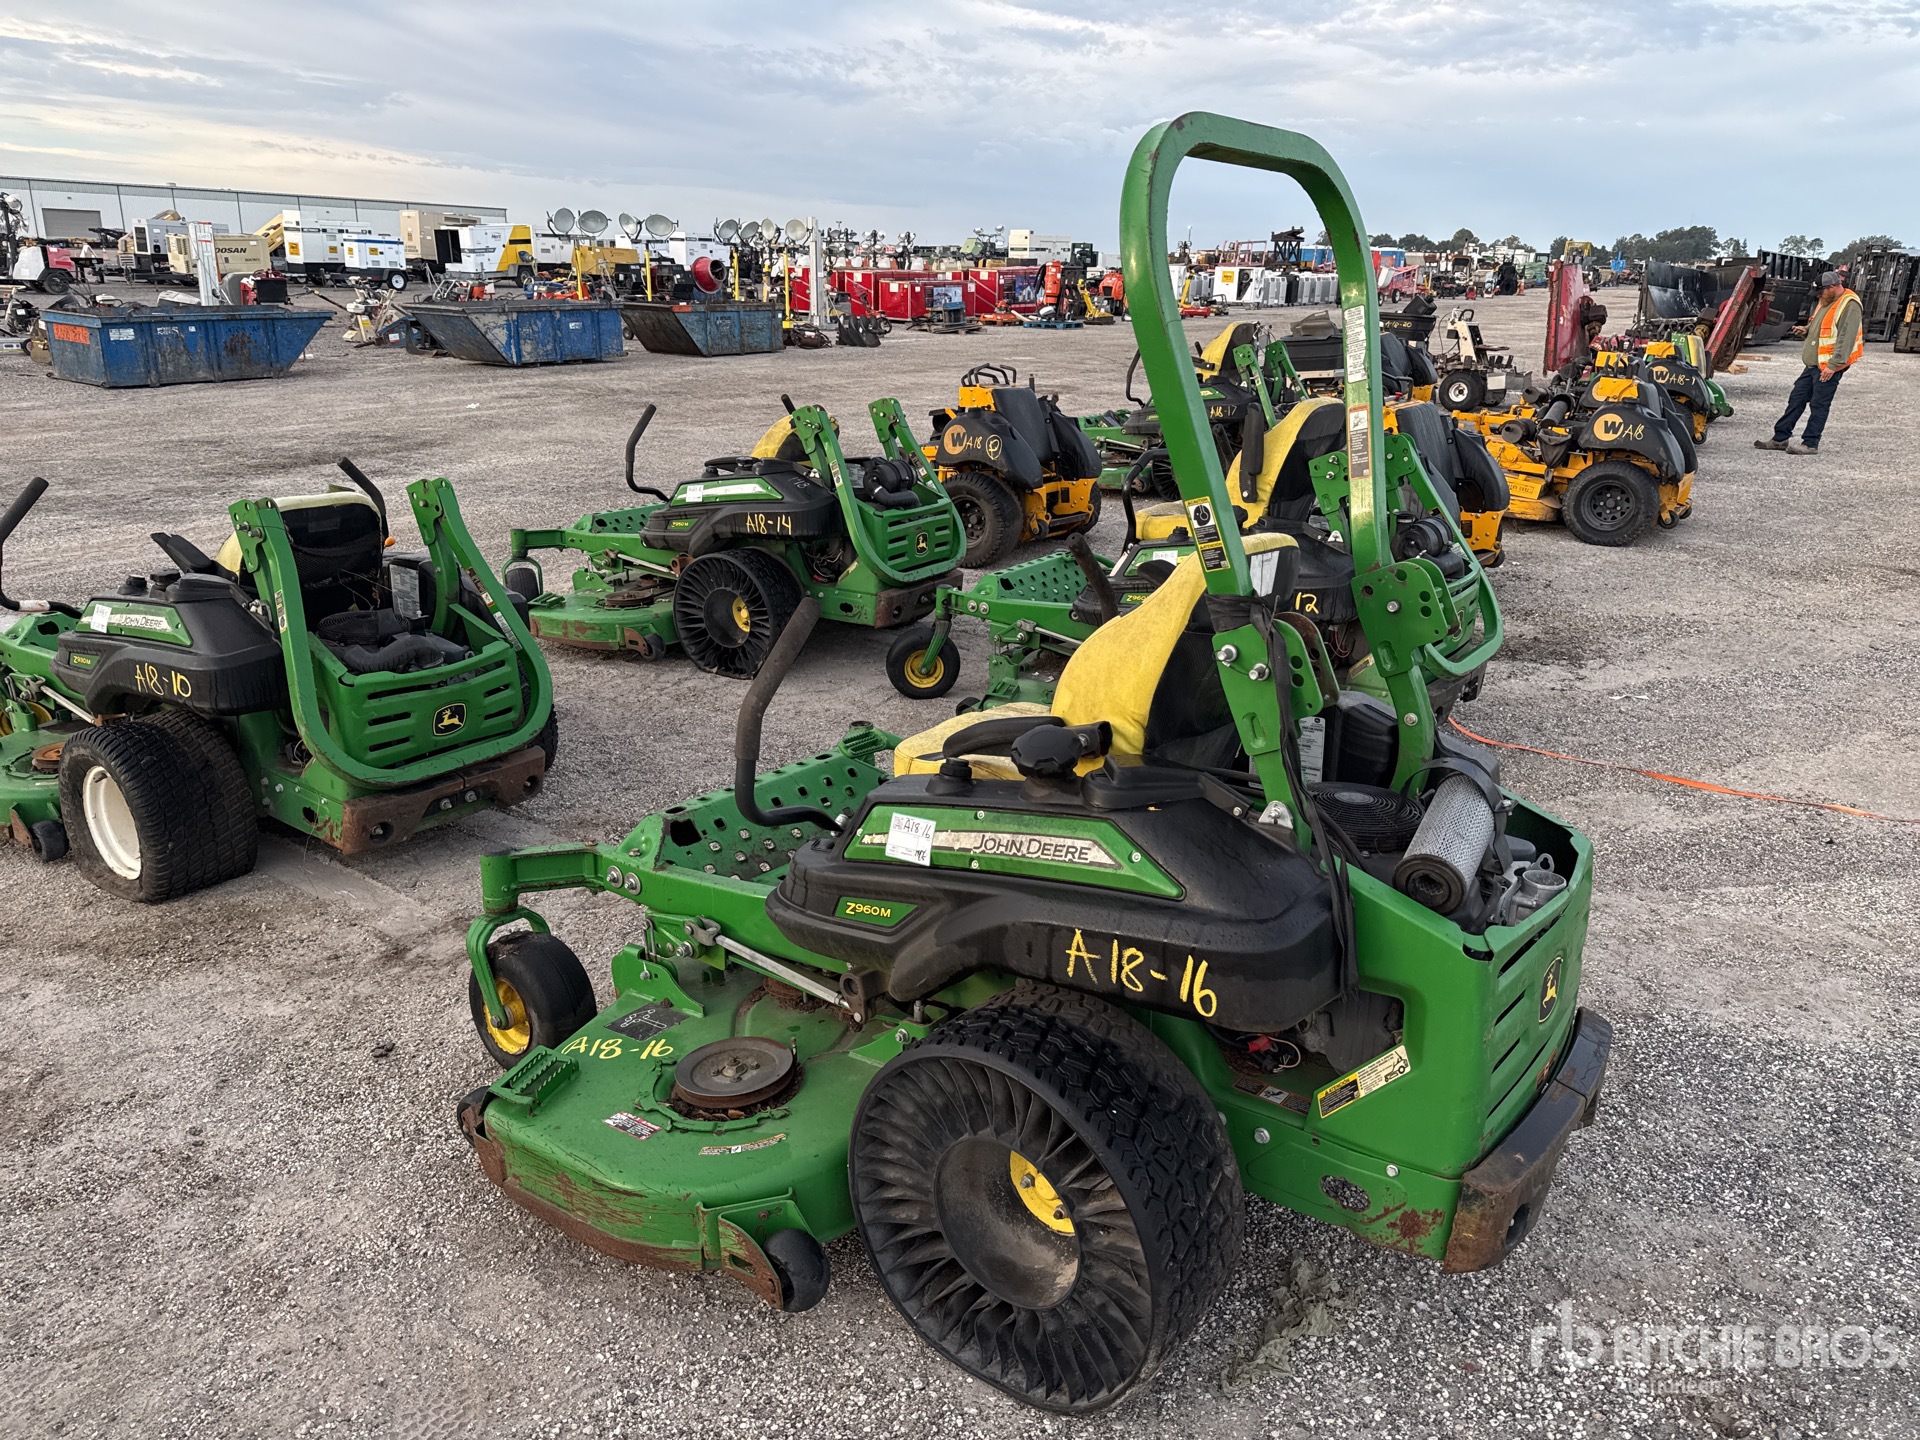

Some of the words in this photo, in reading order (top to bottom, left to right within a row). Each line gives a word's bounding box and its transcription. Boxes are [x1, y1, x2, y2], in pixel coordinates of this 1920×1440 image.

[1655, 371, 1669, 380] W
[1604, 421, 1622, 435] W
[951, 433, 966, 447] W
[746, 512, 791, 535] A18-14
[121, 615, 140, 626] JOHN
[140, 616, 164, 627] DEERE
[135, 663, 191, 697] A18-10
[973, 834, 1023, 854] JOHN
[1026, 838, 1092, 861] DEERE
[846, 902, 891, 918] Z960M
[561, 1036, 674, 1059] A18-16
